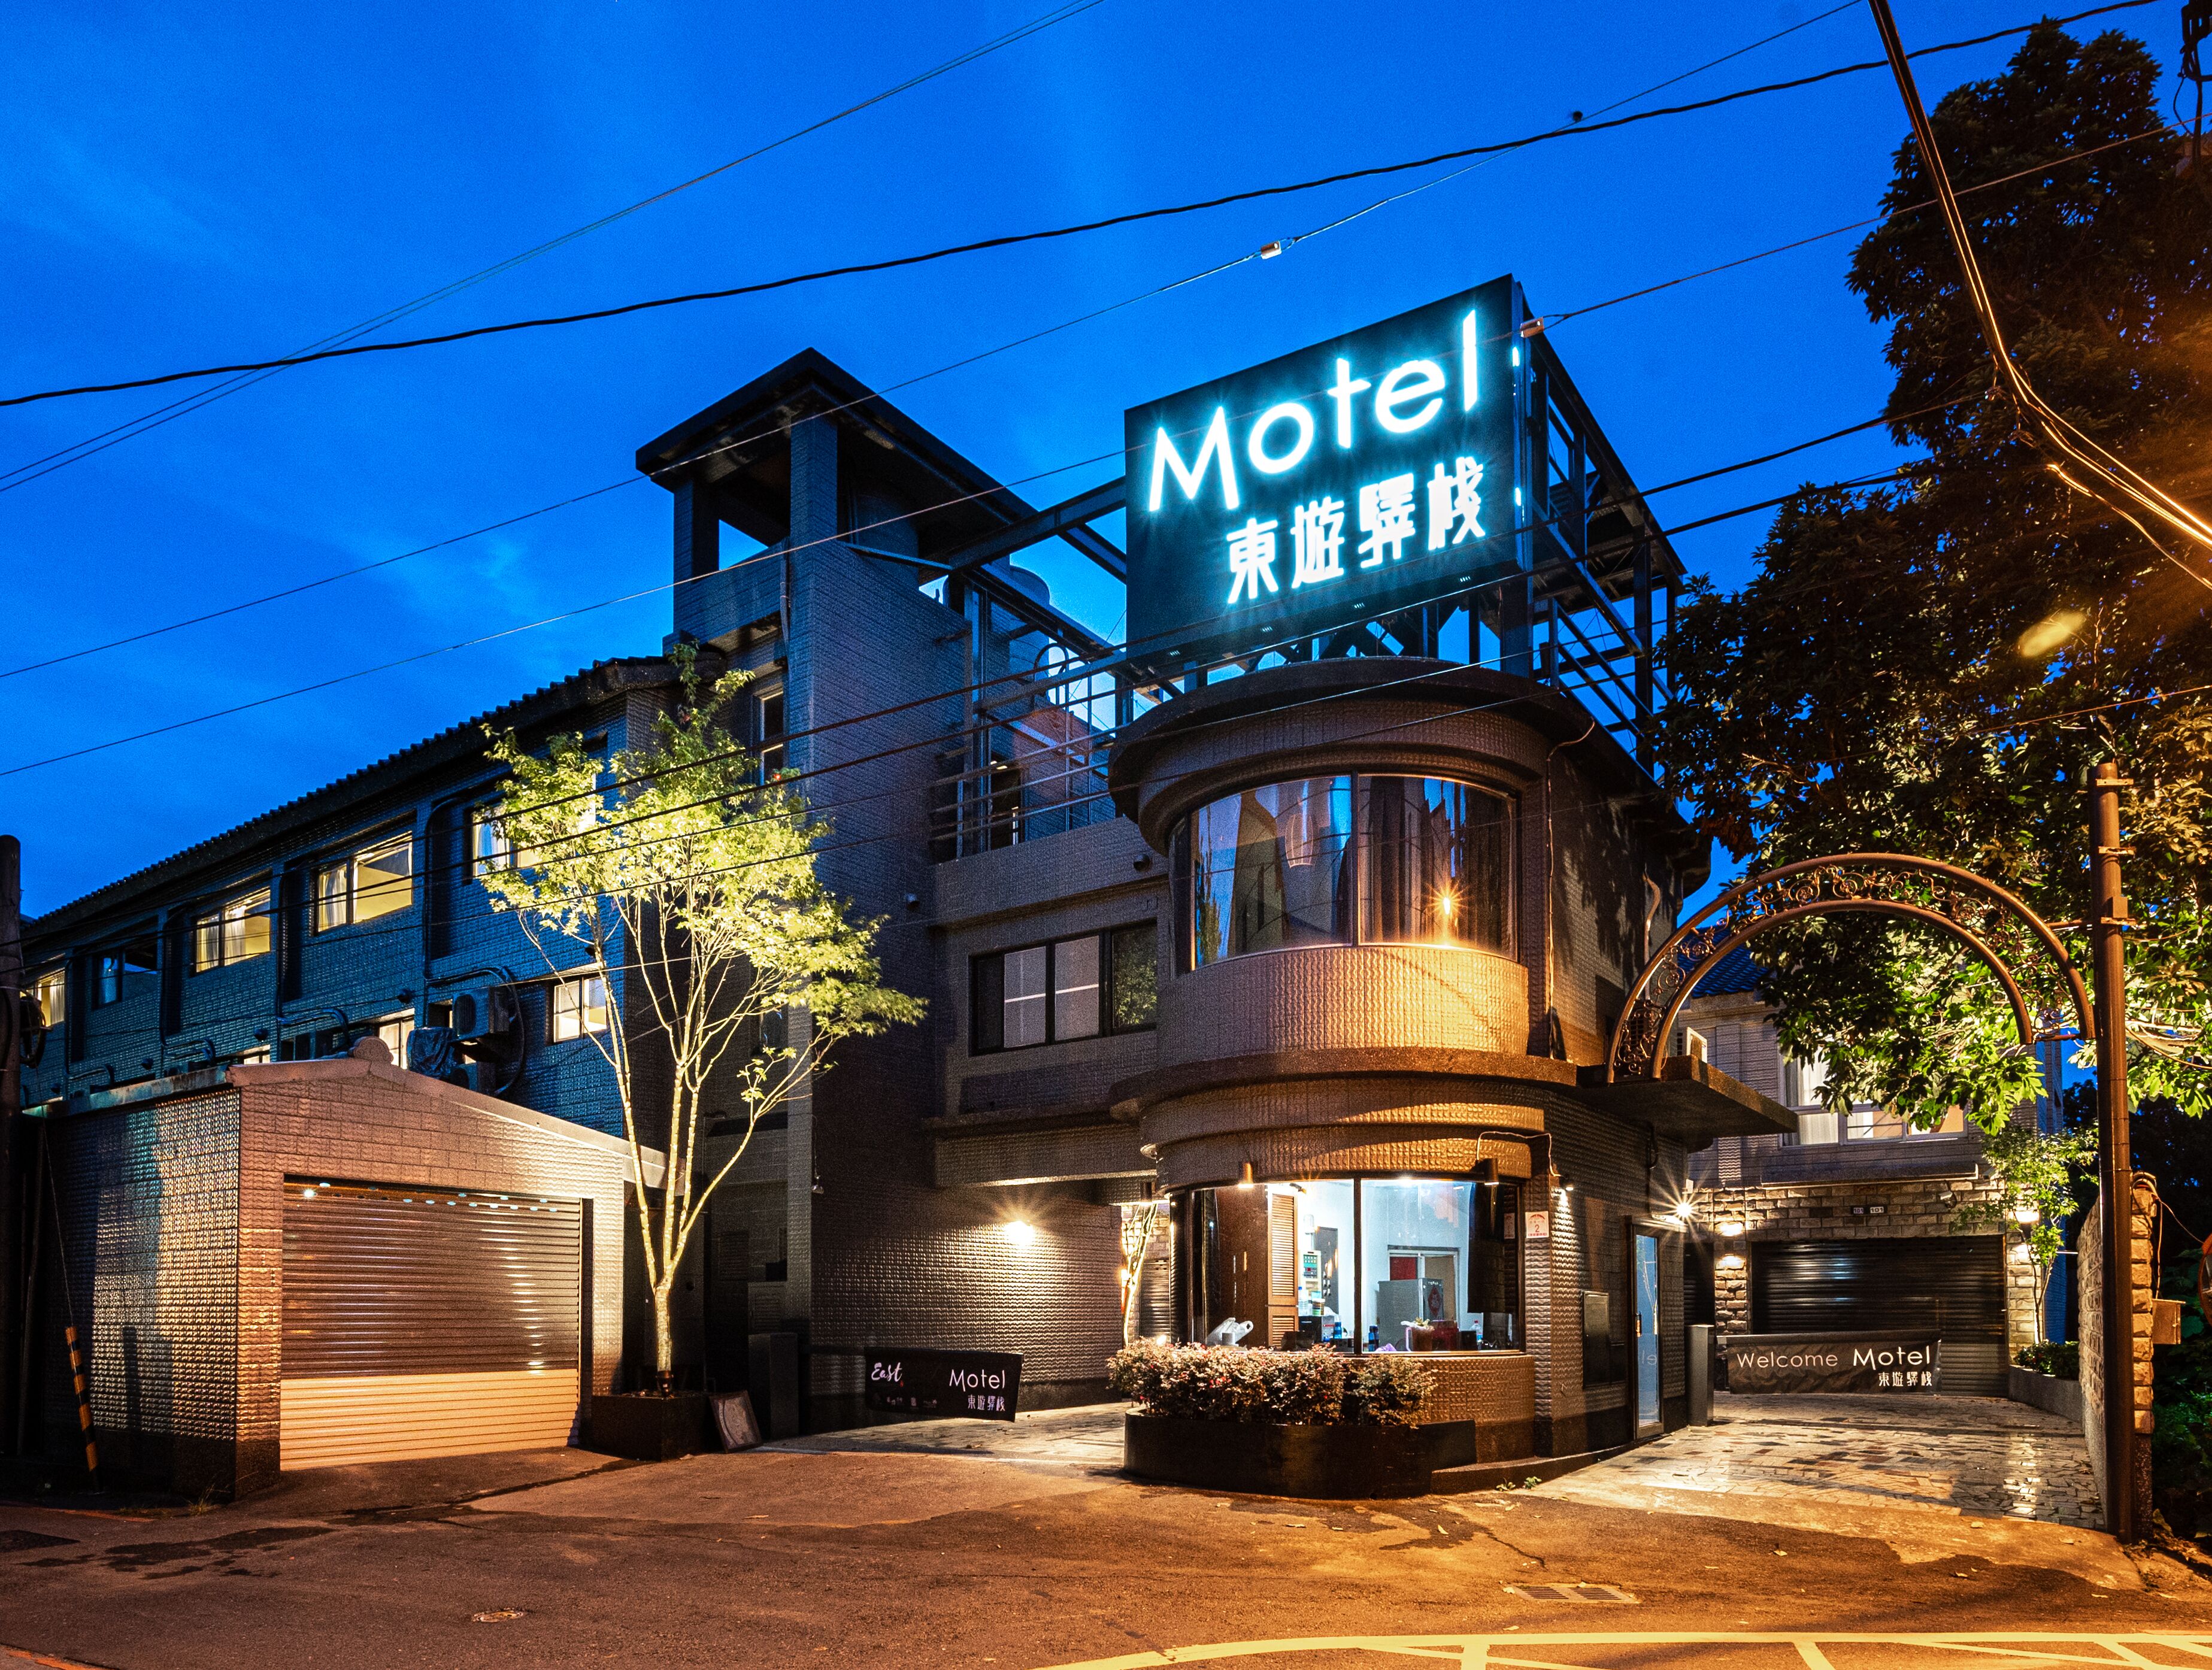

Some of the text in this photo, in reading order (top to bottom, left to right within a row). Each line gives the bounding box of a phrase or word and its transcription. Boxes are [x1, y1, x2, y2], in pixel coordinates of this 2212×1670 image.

[1149, 309, 1478, 511] Motel
[1737, 1345, 1931, 1371] Welcome Motel
[871, 1362, 903, 1382] East
[949, 1368, 1005, 1392] Motel
